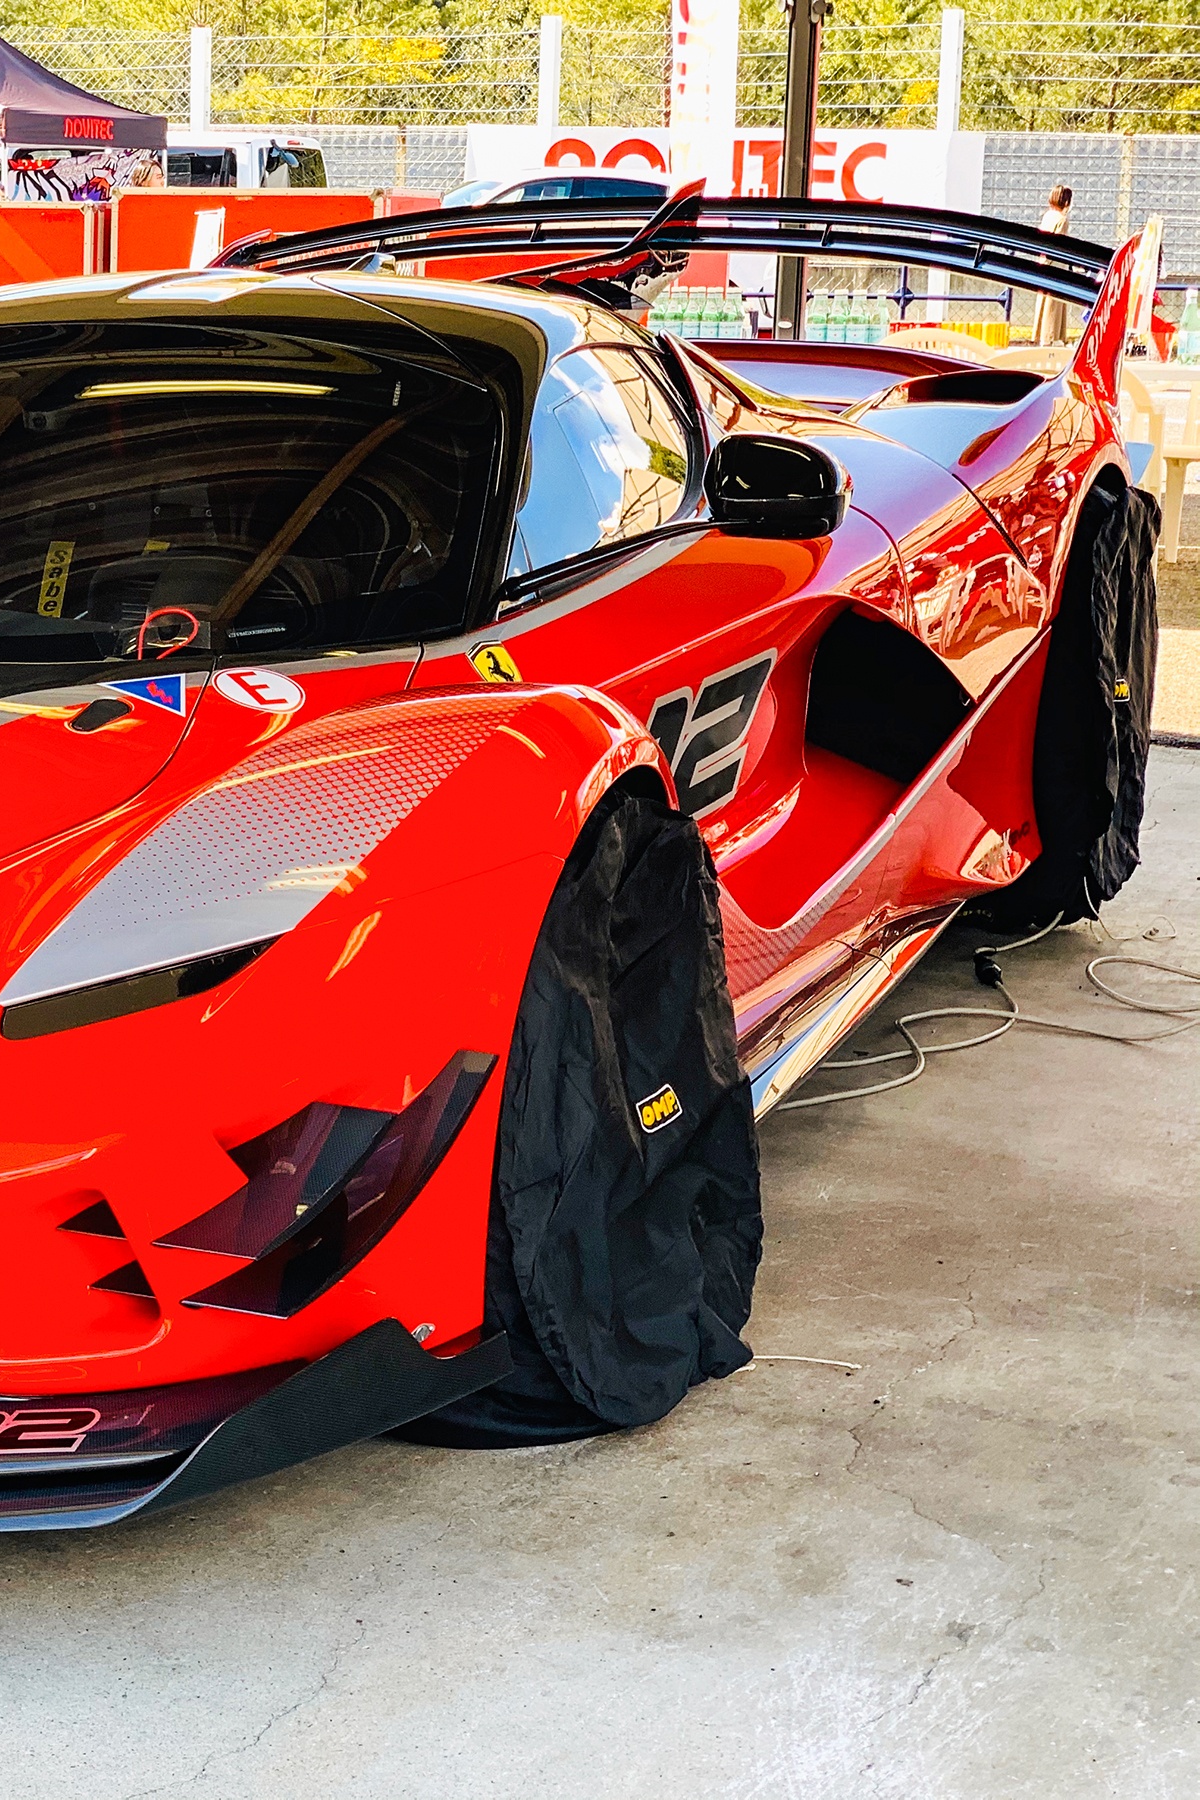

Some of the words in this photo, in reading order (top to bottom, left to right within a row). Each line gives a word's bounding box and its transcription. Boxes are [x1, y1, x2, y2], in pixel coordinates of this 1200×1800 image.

[63, 117, 114, 140] NOVITEC
[42, 549, 68, 612] Sabe
[226, 671, 289, 706] E
